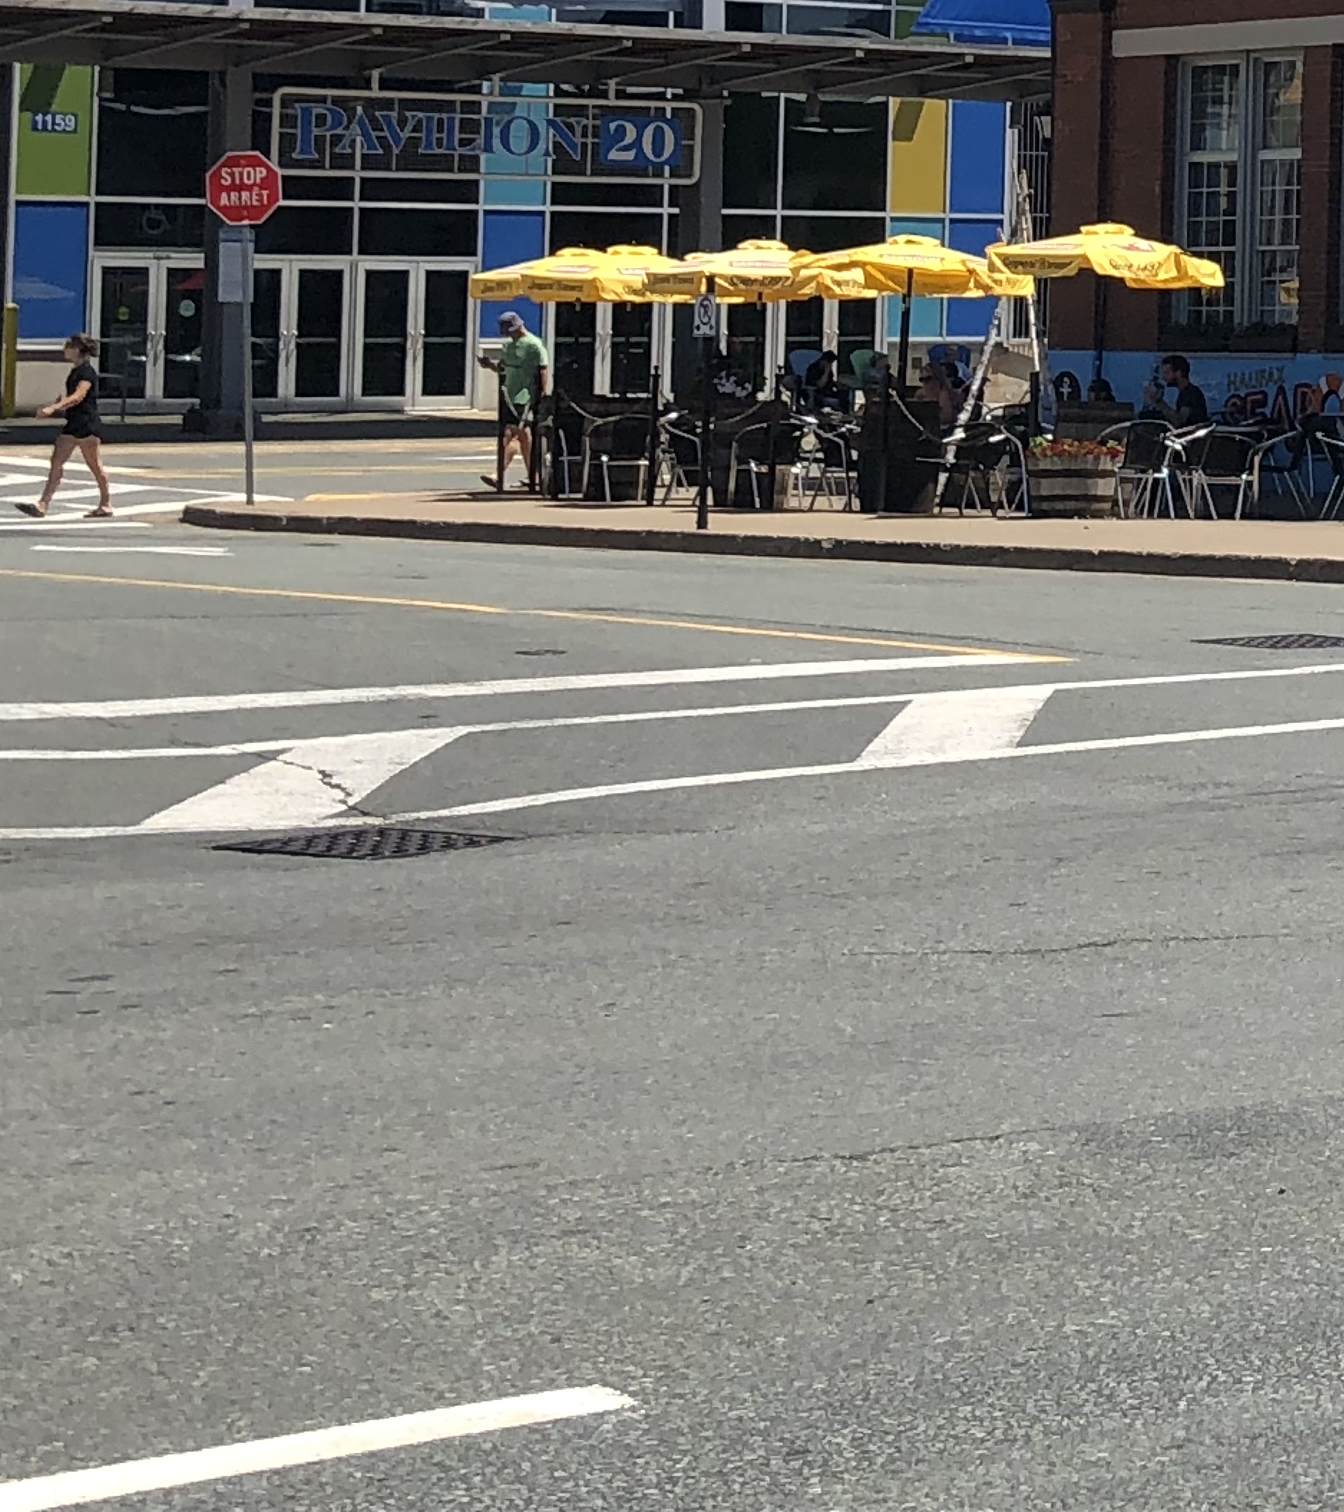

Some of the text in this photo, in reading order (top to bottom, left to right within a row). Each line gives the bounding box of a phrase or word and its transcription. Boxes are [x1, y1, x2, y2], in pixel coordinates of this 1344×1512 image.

[34, 113, 76, 131] 1159
[292, 102, 675, 163] PAVILION 20
[220, 167, 267, 186] STOP
[219, 186, 270, 207] ARRÊT
[1227, 366, 1285, 388] HALIFAX
